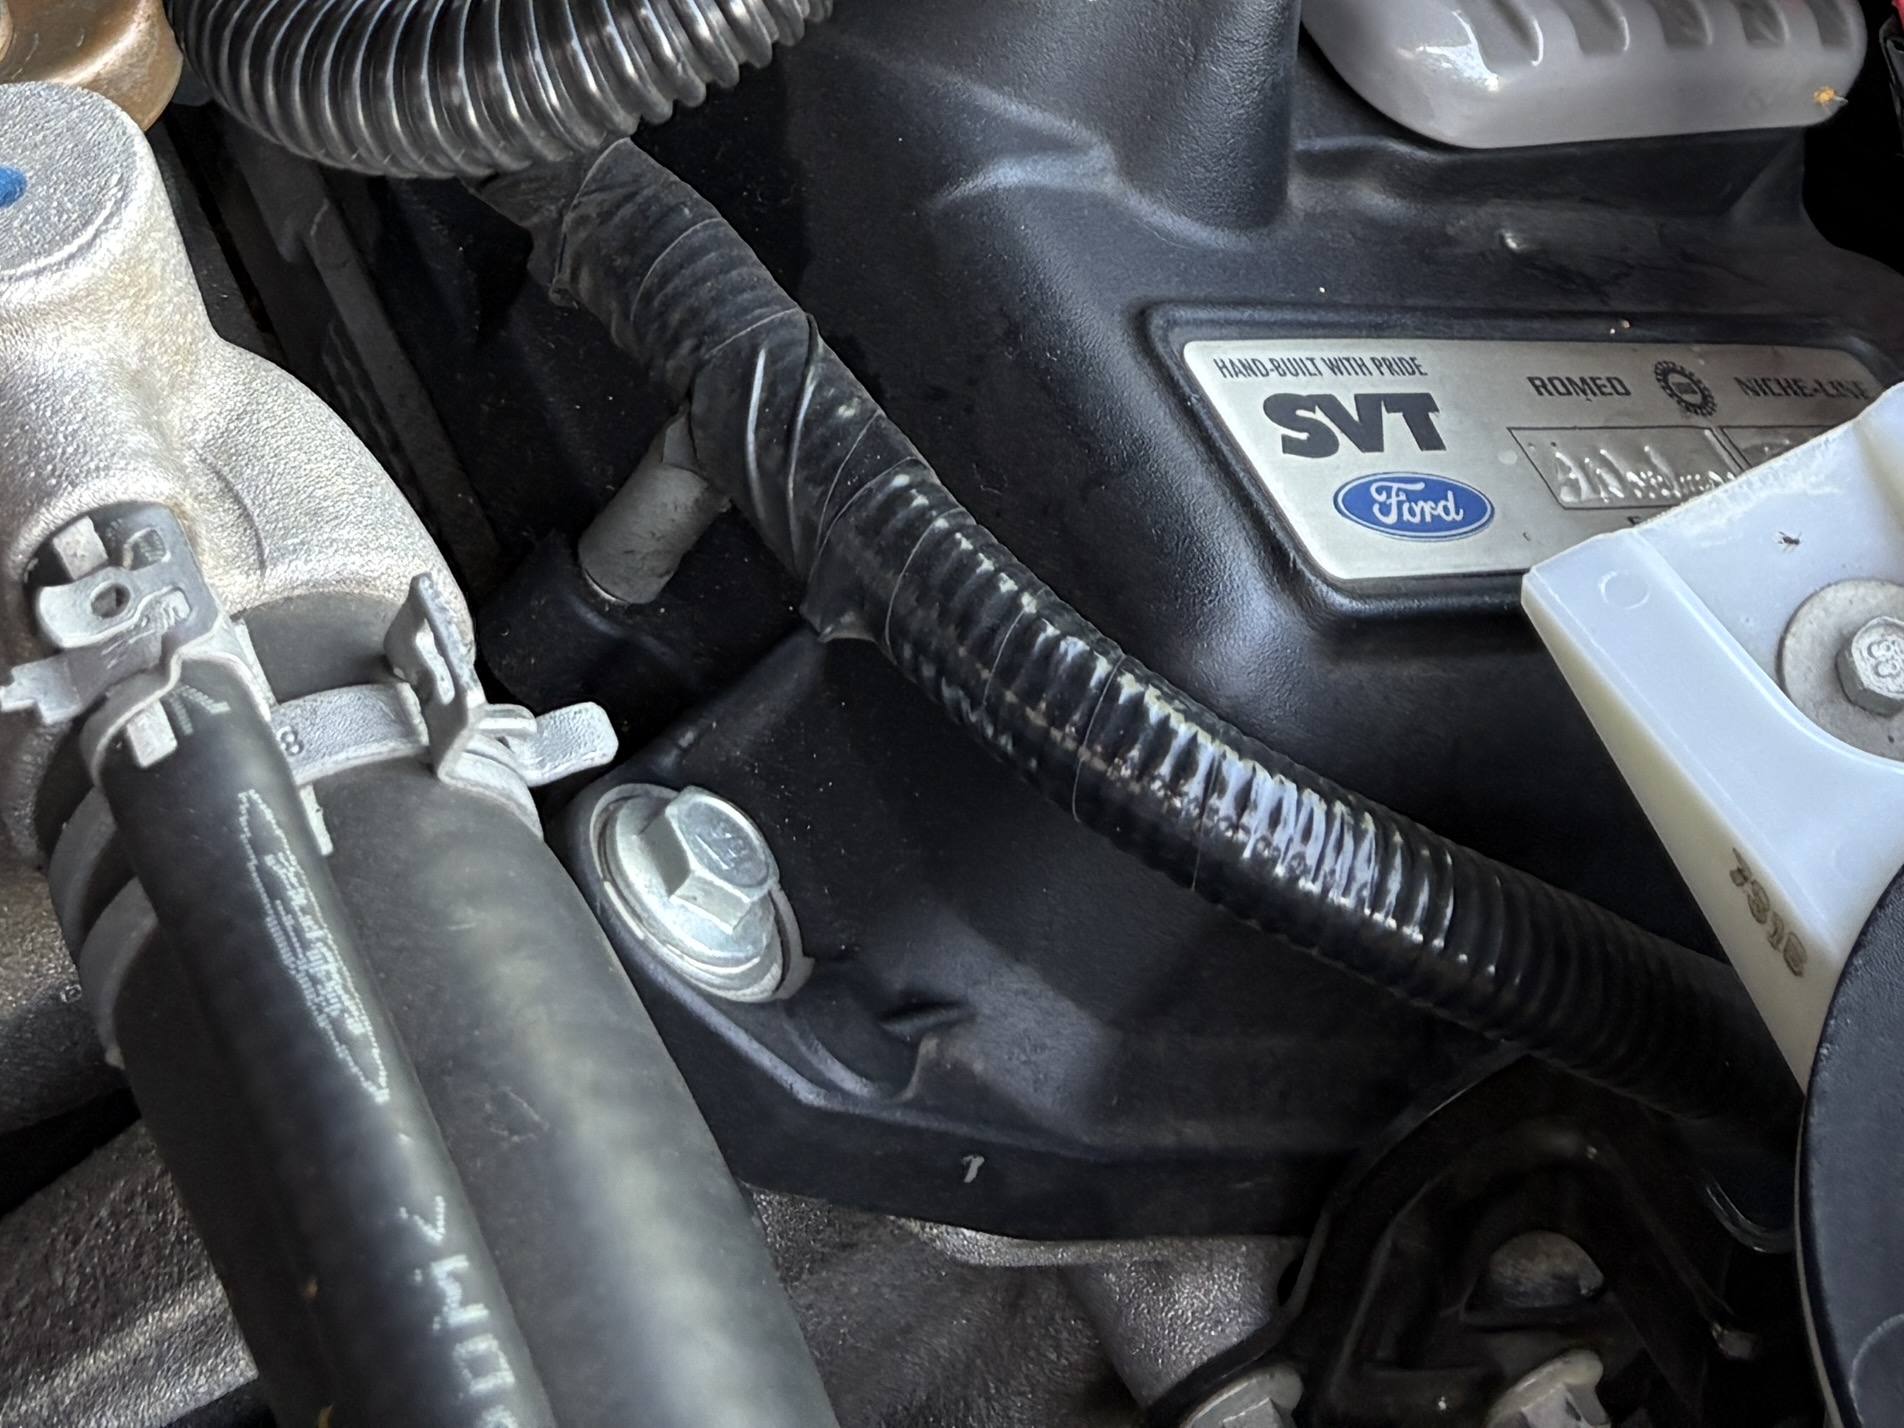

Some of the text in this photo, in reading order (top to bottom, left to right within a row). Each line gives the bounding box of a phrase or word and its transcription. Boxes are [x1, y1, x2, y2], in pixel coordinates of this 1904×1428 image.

[1213, 356, 1428, 379] HAND-BUILT WITH PRIDE
[1263, 392, 1447, 459] SVT
[1370, 480, 1464, 525] Ford
